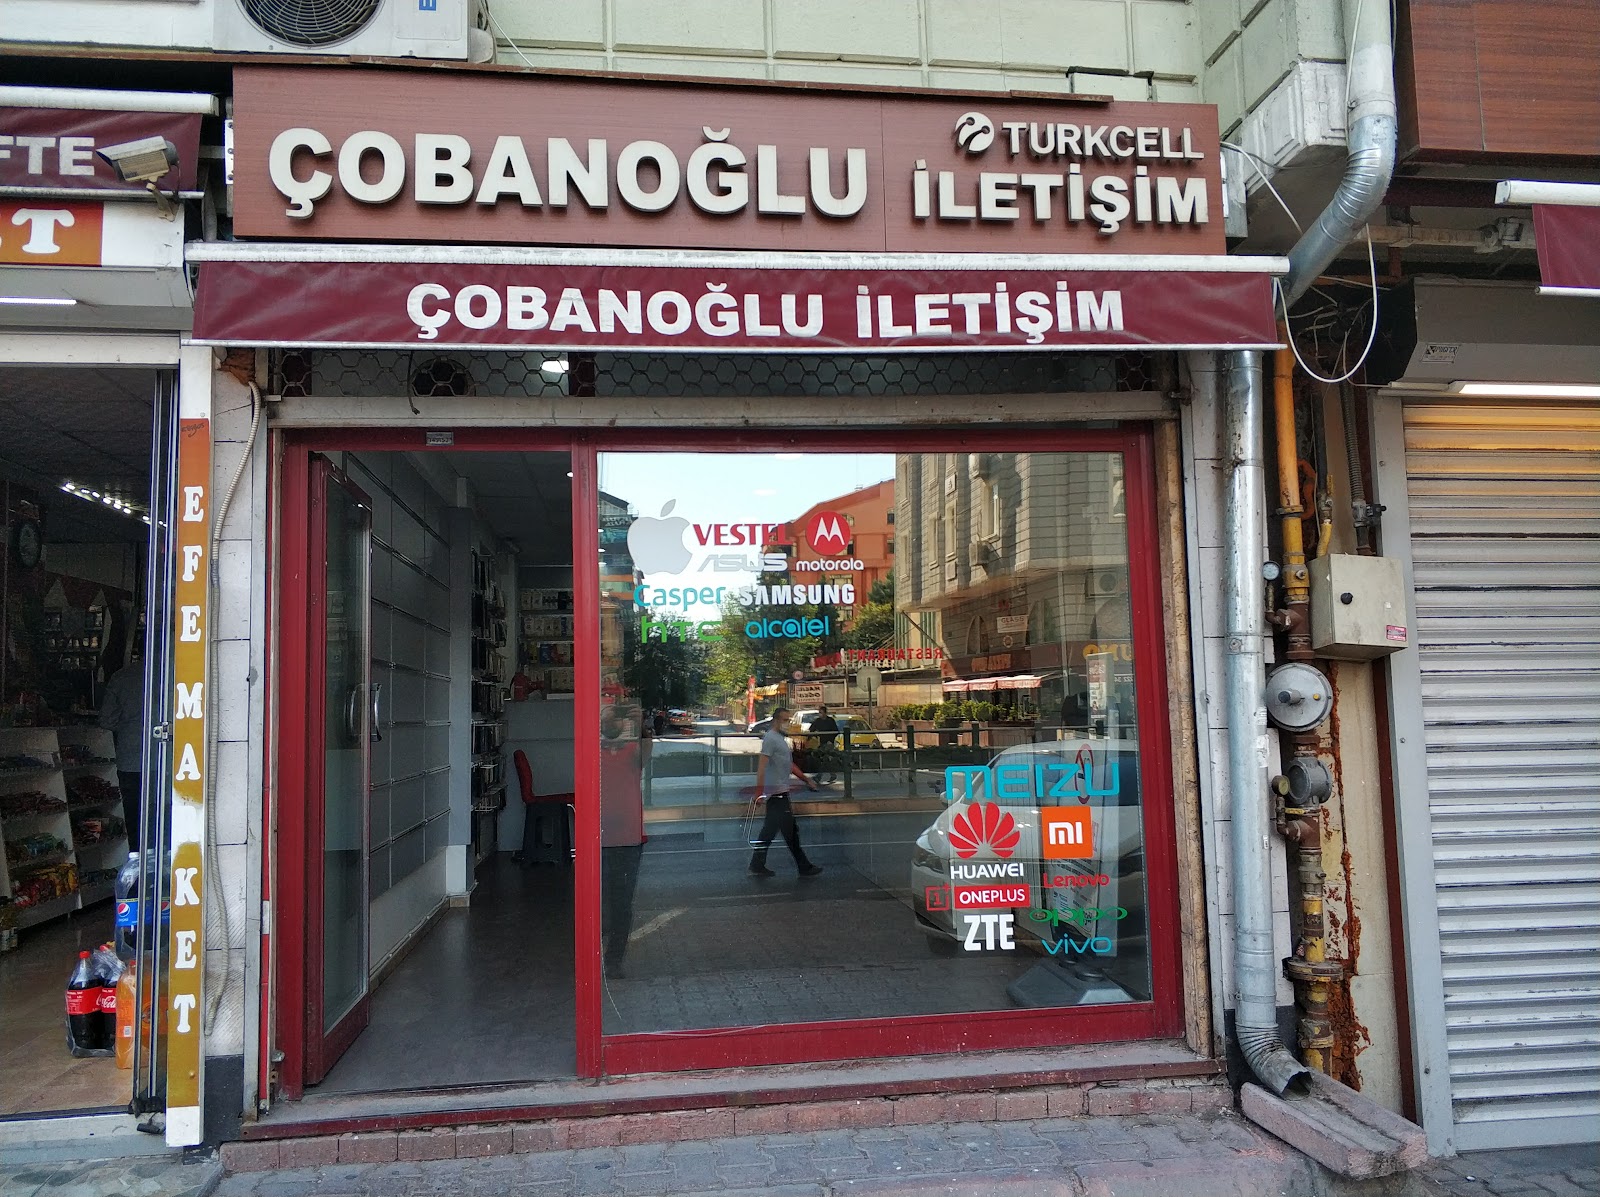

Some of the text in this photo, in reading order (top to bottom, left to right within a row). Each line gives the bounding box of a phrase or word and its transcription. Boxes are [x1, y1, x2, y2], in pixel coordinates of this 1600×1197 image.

[1001, 121, 1204, 160] TURKCELL
[268, 125, 868, 219] ÇOBANOĞLU
[914, 158, 1209, 234] İLETİŞİM
[405, 280, 1124, 344] ÇOBANOĞLU İLETİŞİM
[693, 523, 796, 546] VESTEL
[697, 553, 788, 572] ASUS
[796, 557, 864, 571] motorola
[633, 584, 855, 611] Casper SAMSUNG
[745, 615, 829, 639] alcatel
[945, 762, 1120, 800] MEIZU
[174, 682, 203, 1033] MAKET
[950, 862, 1024, 879] HUAWEI
[1043, 873, 1110, 888] Lenovo
[959, 888, 1025, 904] ONEPLUS
[963, 914, 1016, 951] ZTE
[1041, 933, 1112, 954] vivo
